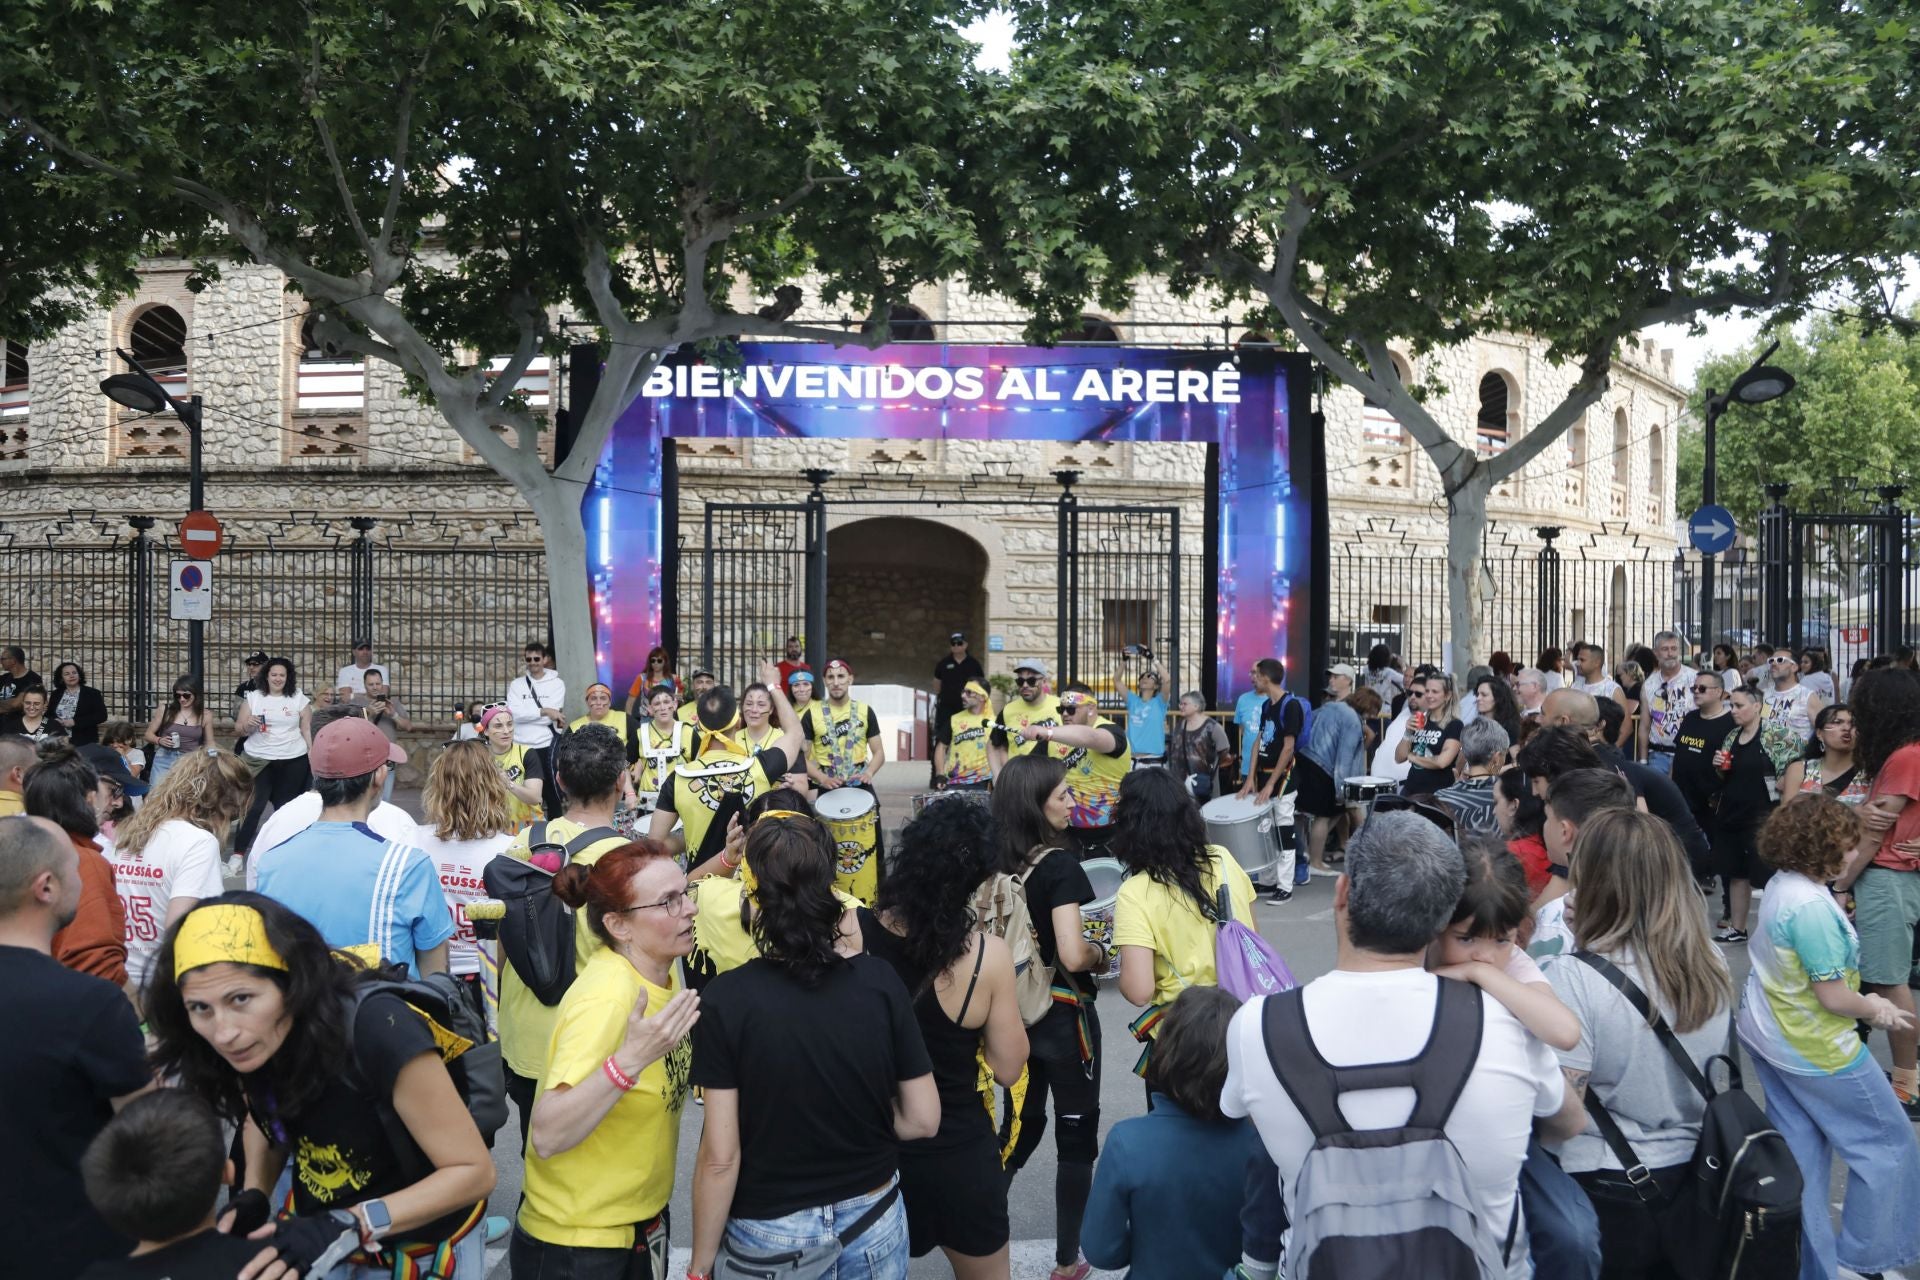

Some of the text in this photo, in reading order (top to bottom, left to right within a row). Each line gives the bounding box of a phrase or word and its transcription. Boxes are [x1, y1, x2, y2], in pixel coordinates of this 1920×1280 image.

[642, 362, 1241, 403] BIENVENIDOS AL ARERÊ
